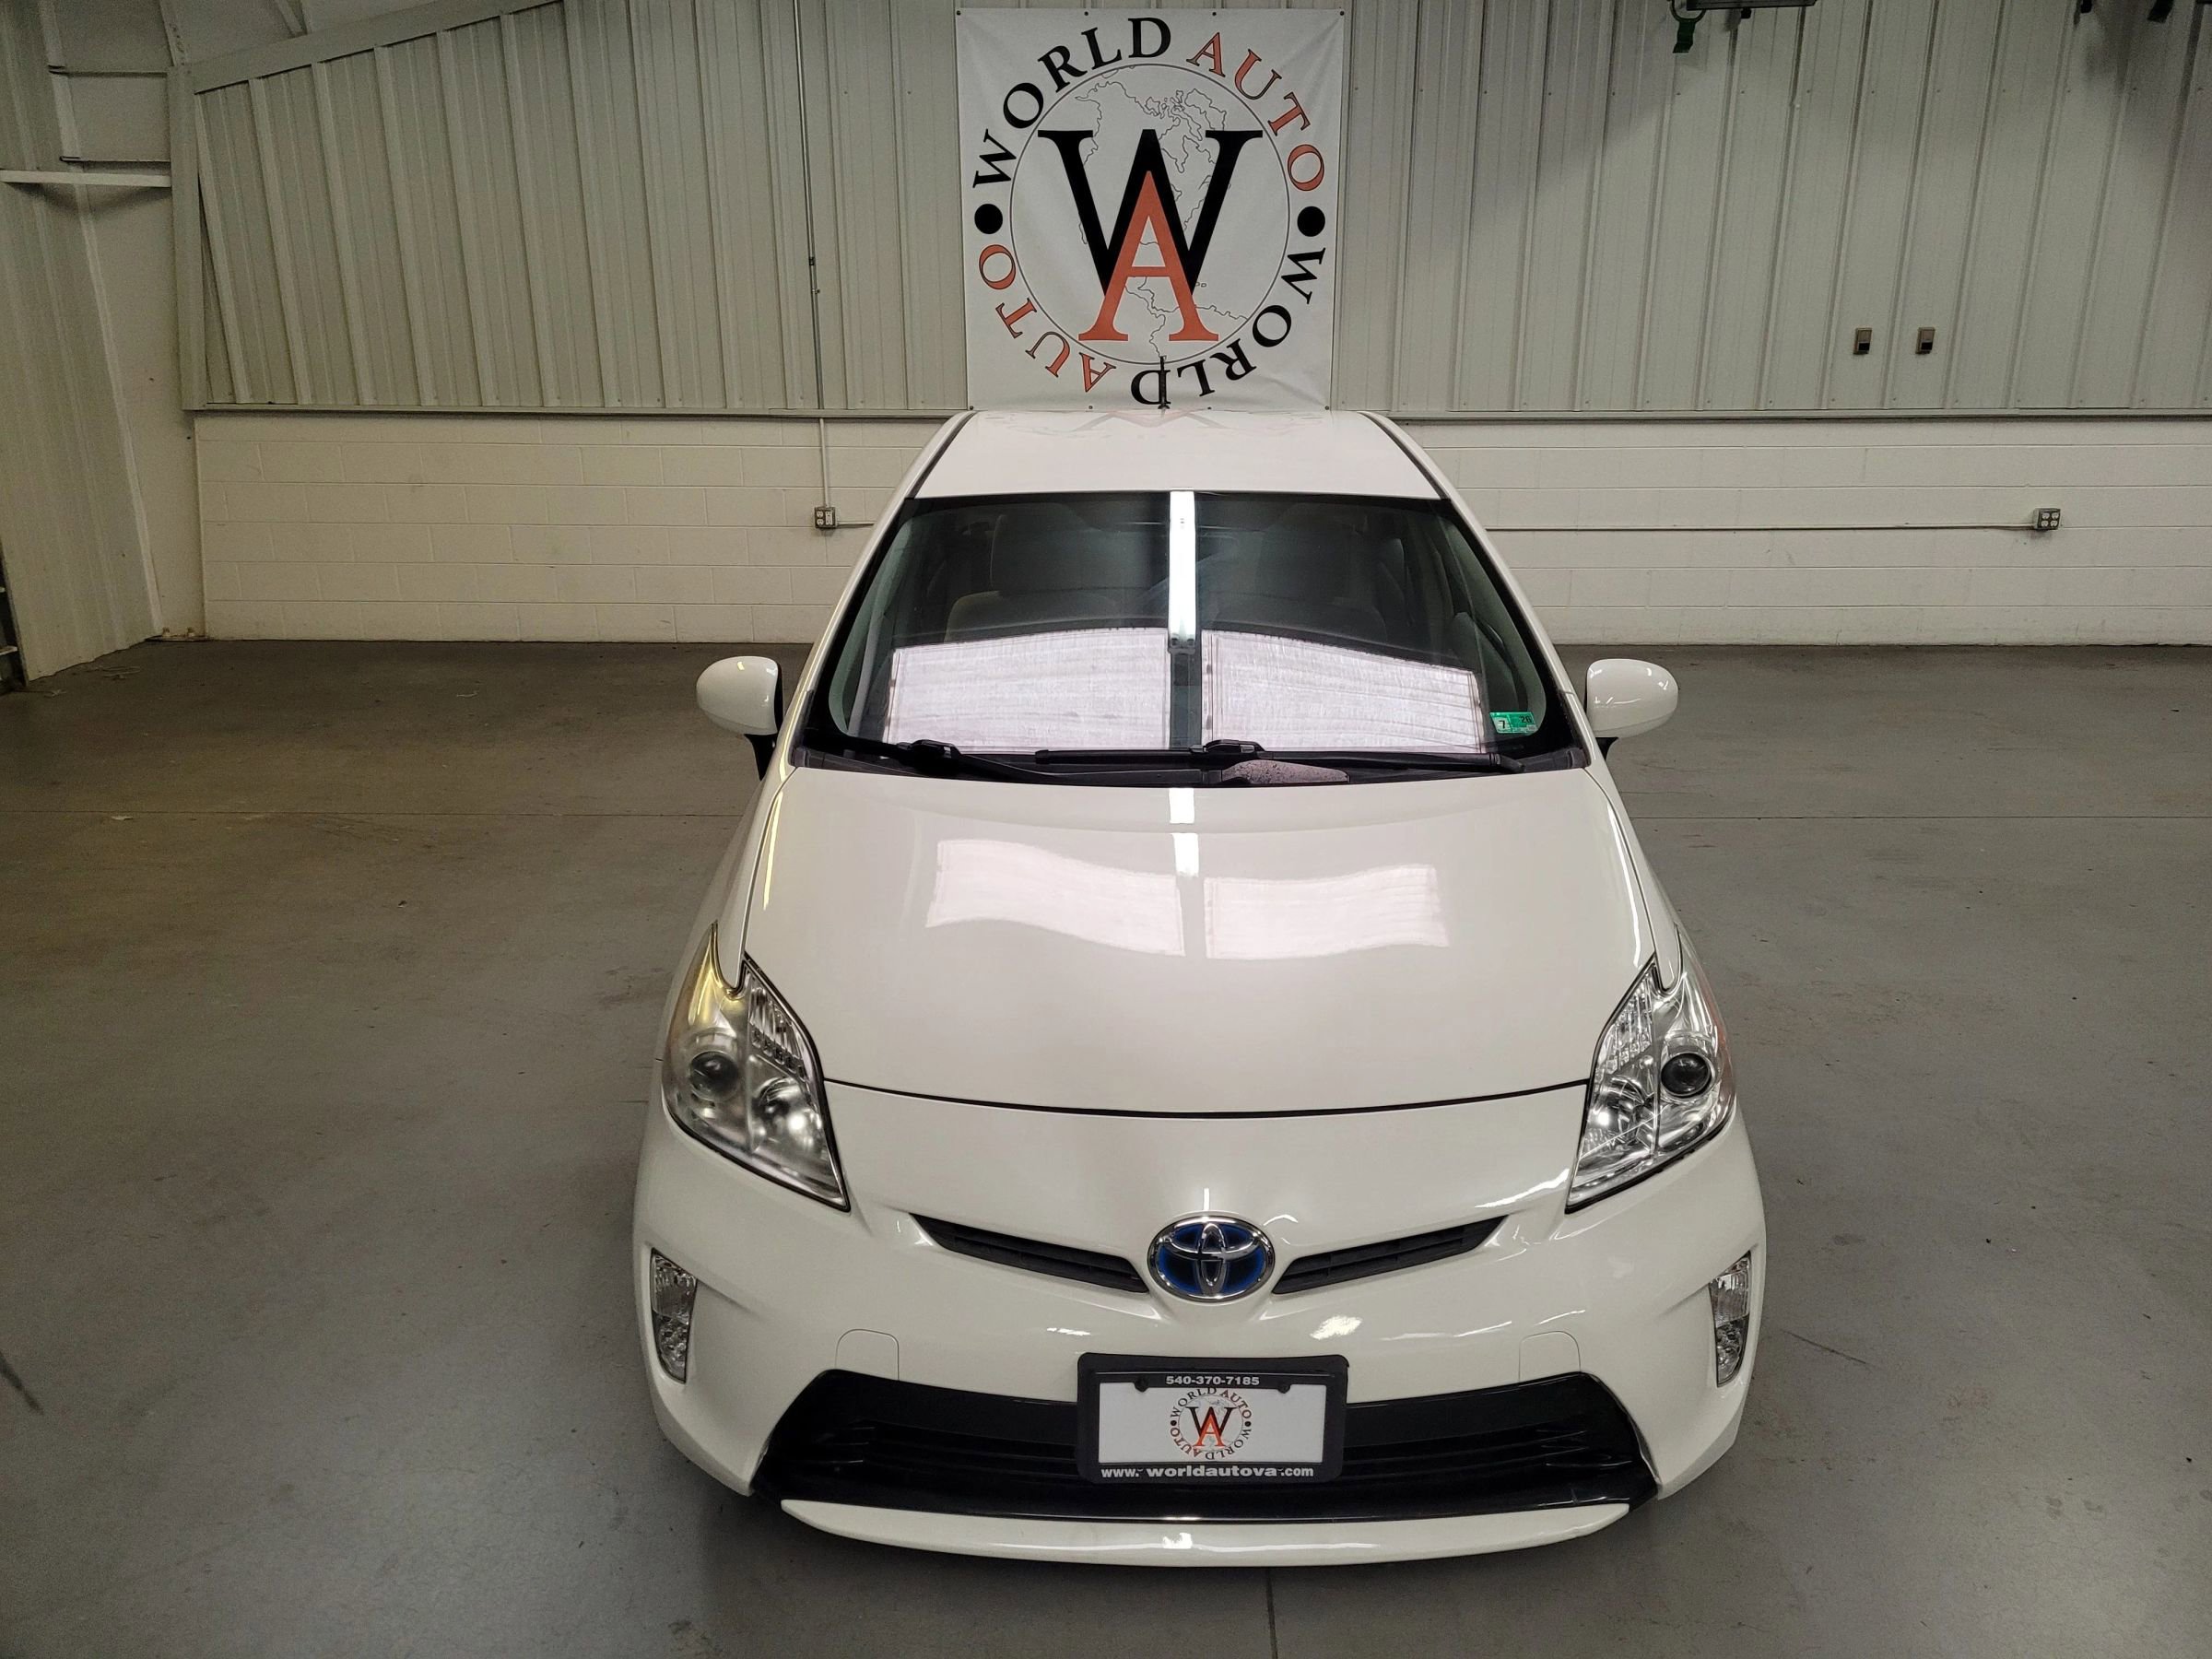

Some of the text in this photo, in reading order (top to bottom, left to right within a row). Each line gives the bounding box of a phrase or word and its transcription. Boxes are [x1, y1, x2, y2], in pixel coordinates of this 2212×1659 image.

[971, 17, 1325, 192] WORLD AUTO
[978, 243, 1326, 406] WORLD AUTO
[1165, 1375, 1260, 1385] 540-370-7185
[1171, 1387, 1253, 1418] WORLD AUTO
[1170, 1427, 1252, 1460] WORLD AUTO
